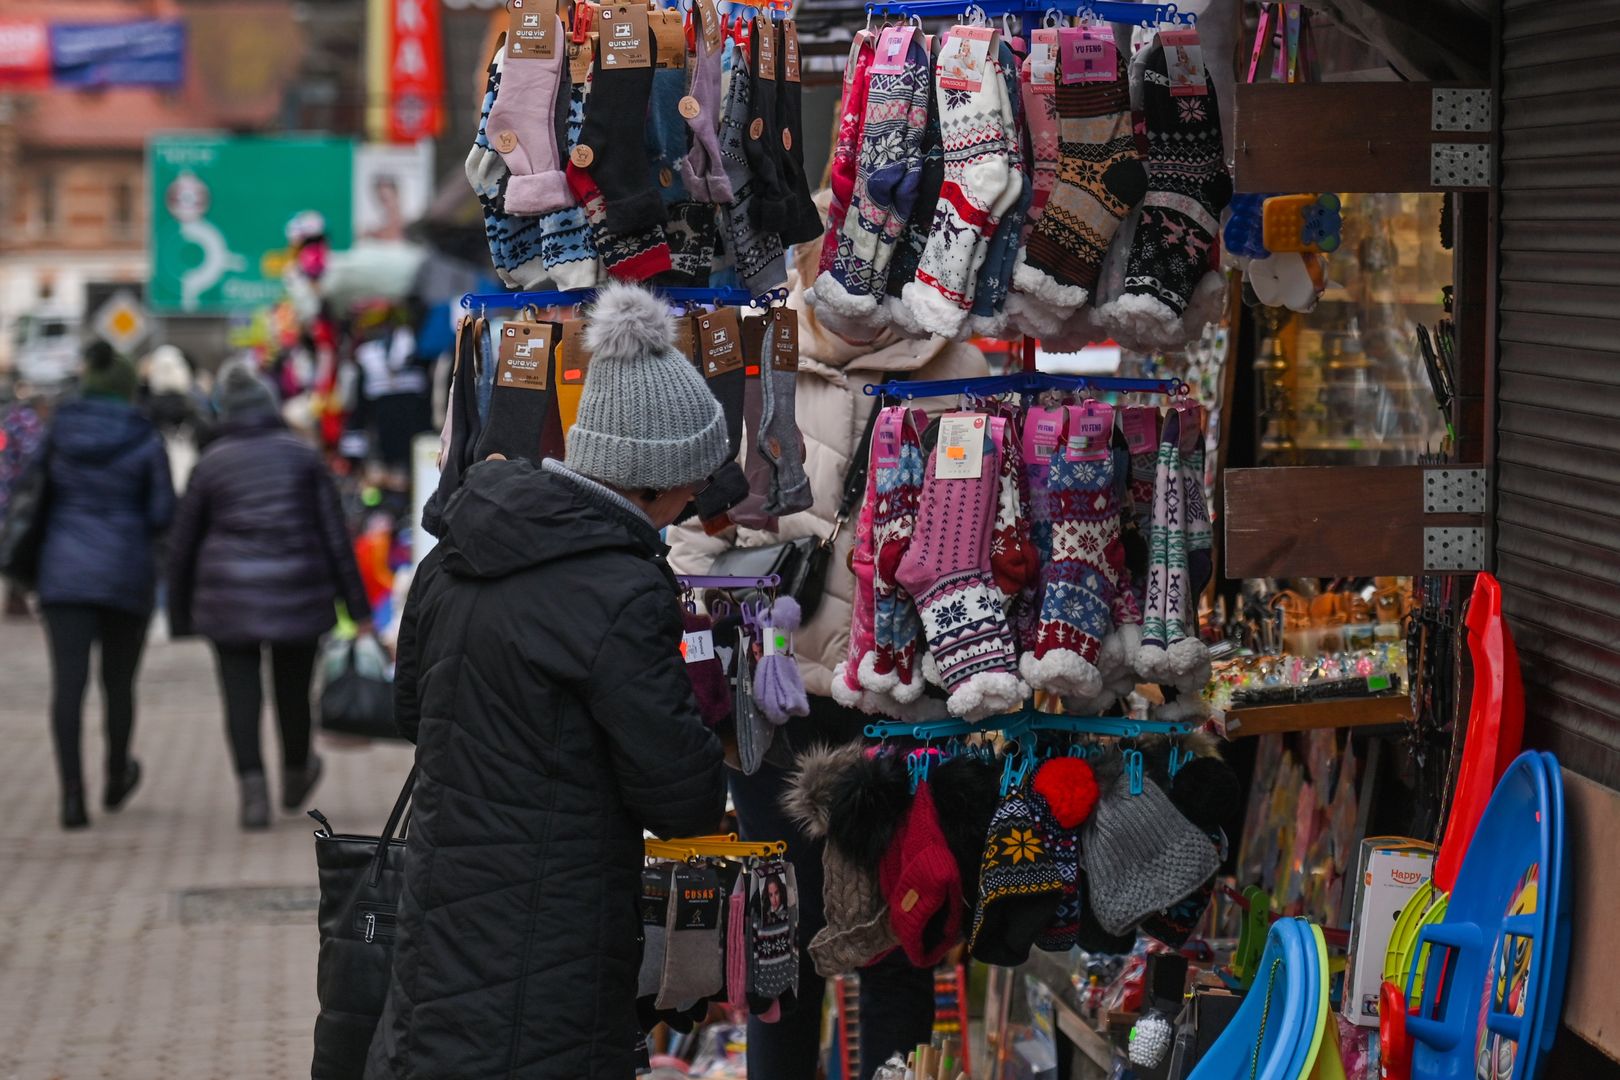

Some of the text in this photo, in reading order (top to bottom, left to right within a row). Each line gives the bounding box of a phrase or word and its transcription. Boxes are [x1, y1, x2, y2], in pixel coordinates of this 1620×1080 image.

[1075, 45, 1101, 53] YU FENG
[1391, 869, 1421, 880] Happy
